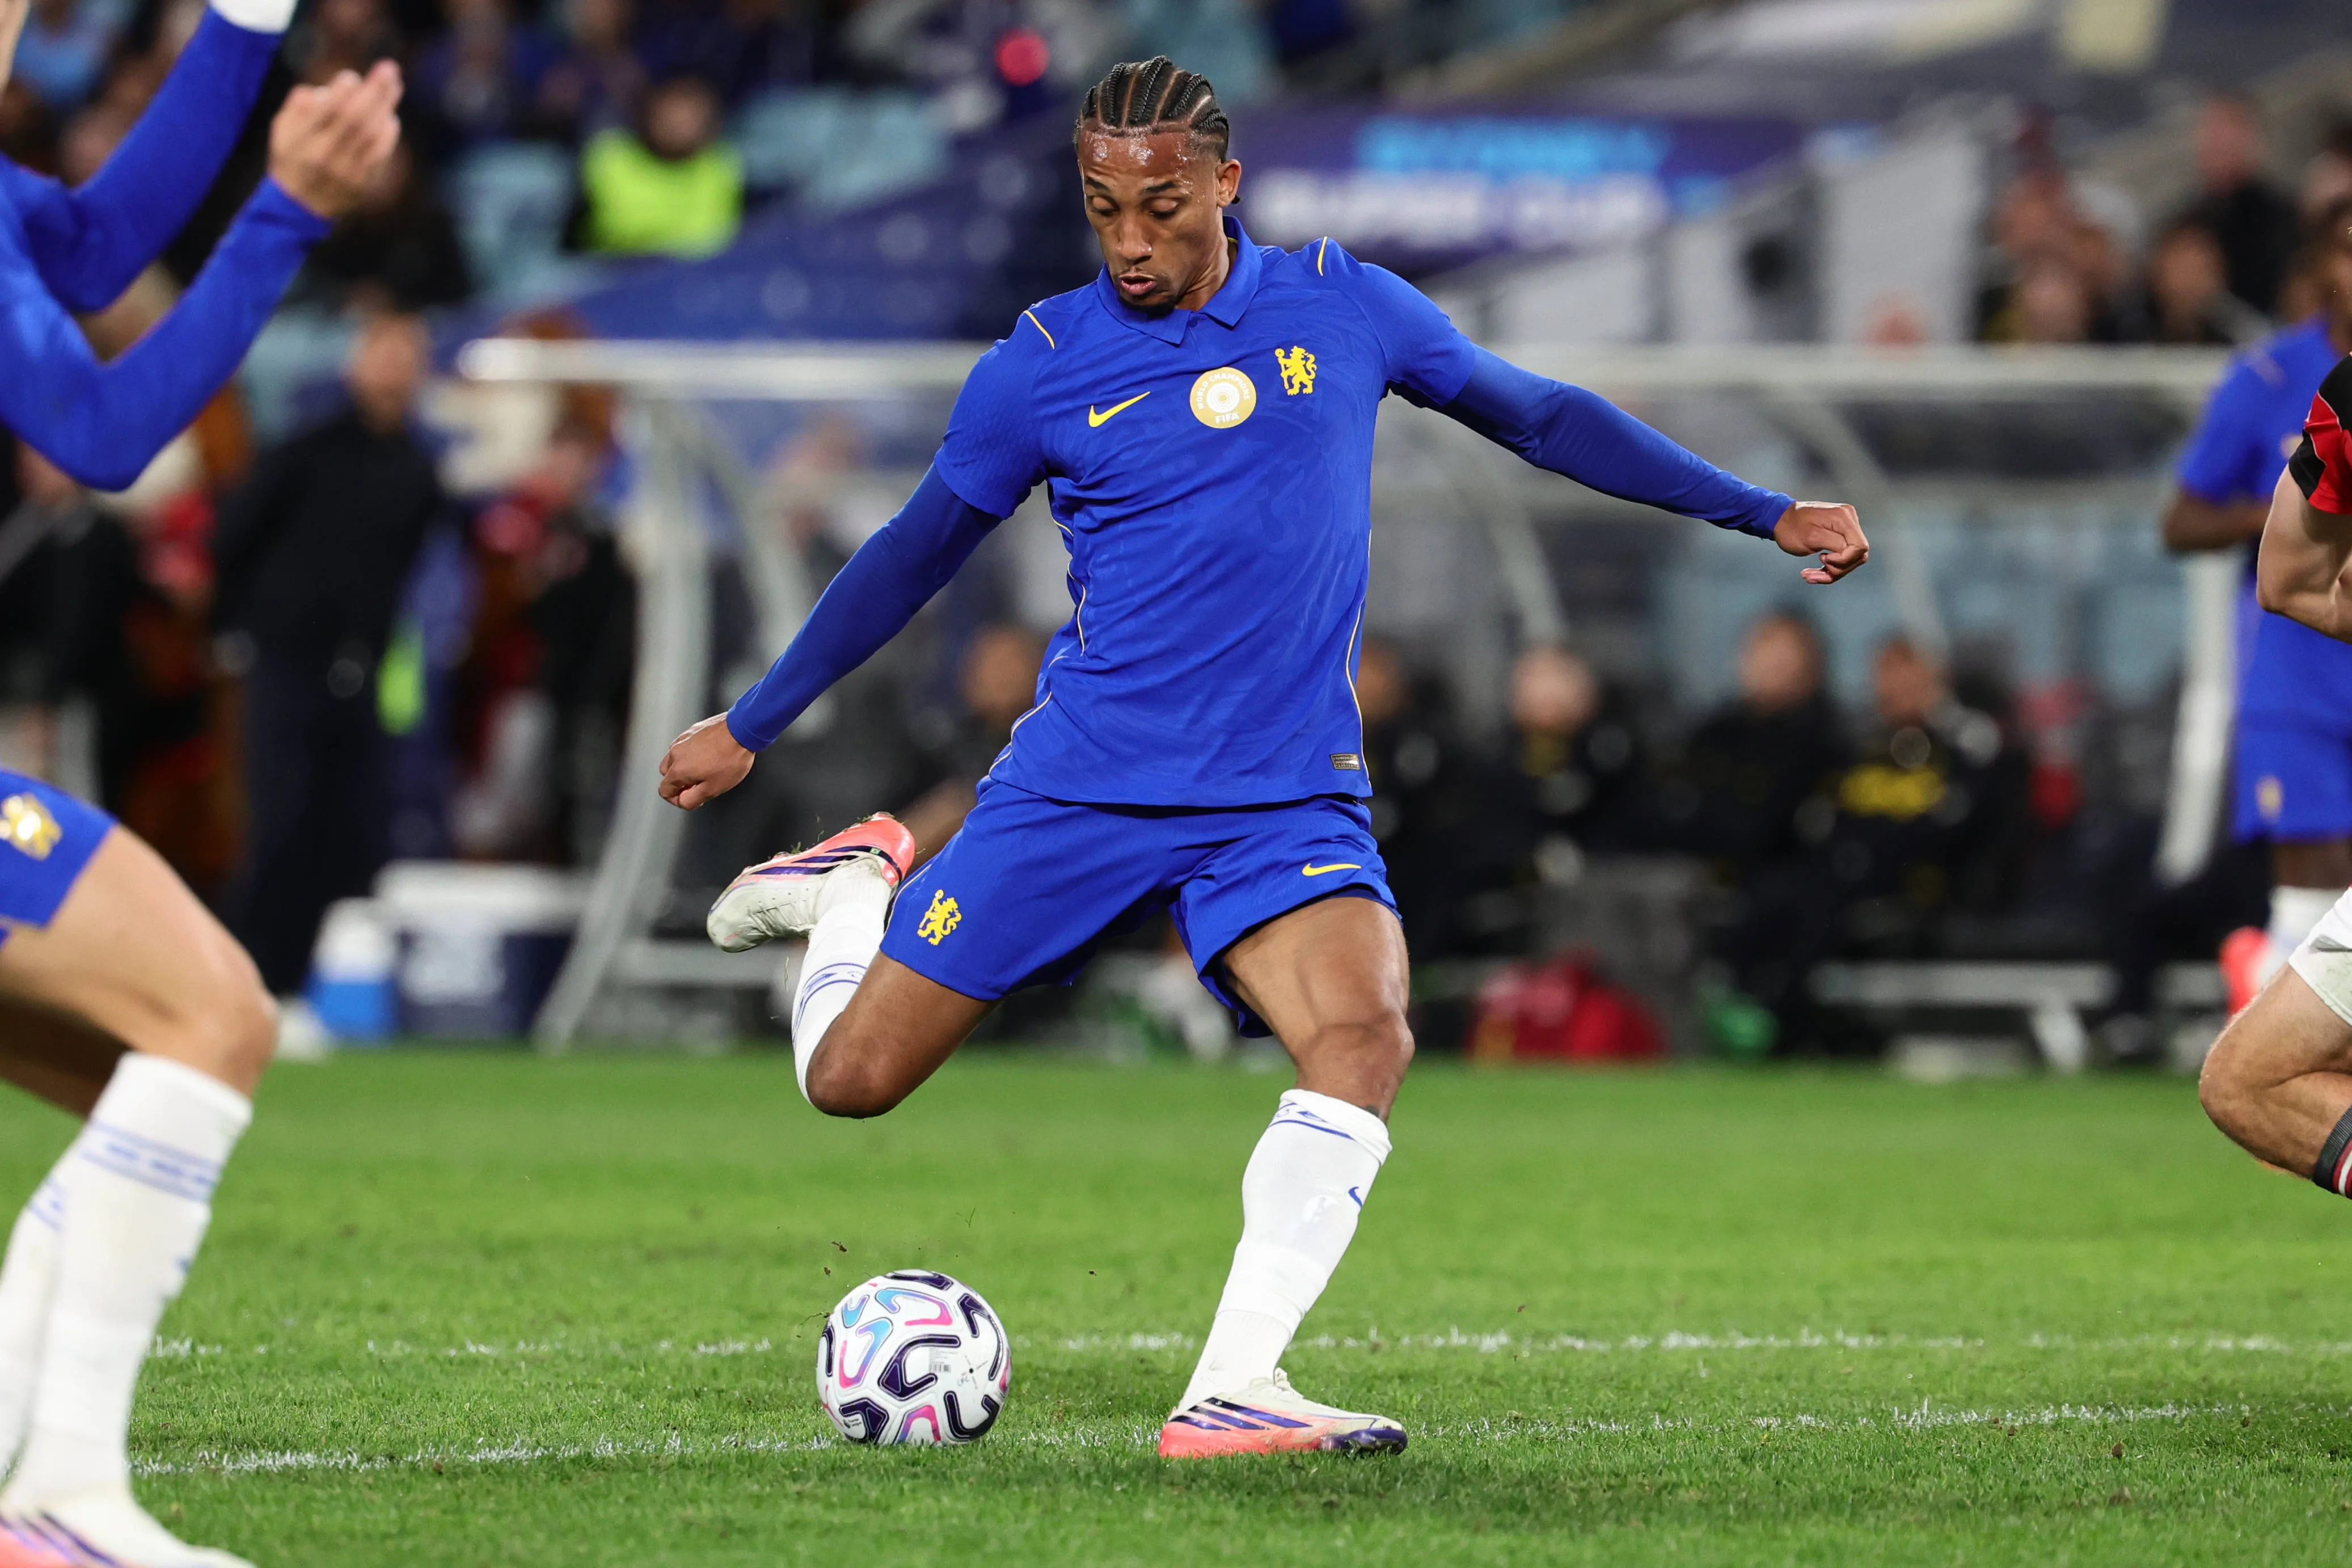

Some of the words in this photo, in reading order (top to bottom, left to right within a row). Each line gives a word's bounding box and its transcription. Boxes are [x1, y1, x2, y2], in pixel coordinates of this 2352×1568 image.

[1196, 381, 1209, 410] WORLD
[1209, 373, 1250, 400] CHAMPIONS
[1215, 412, 1240, 424] FIFA
